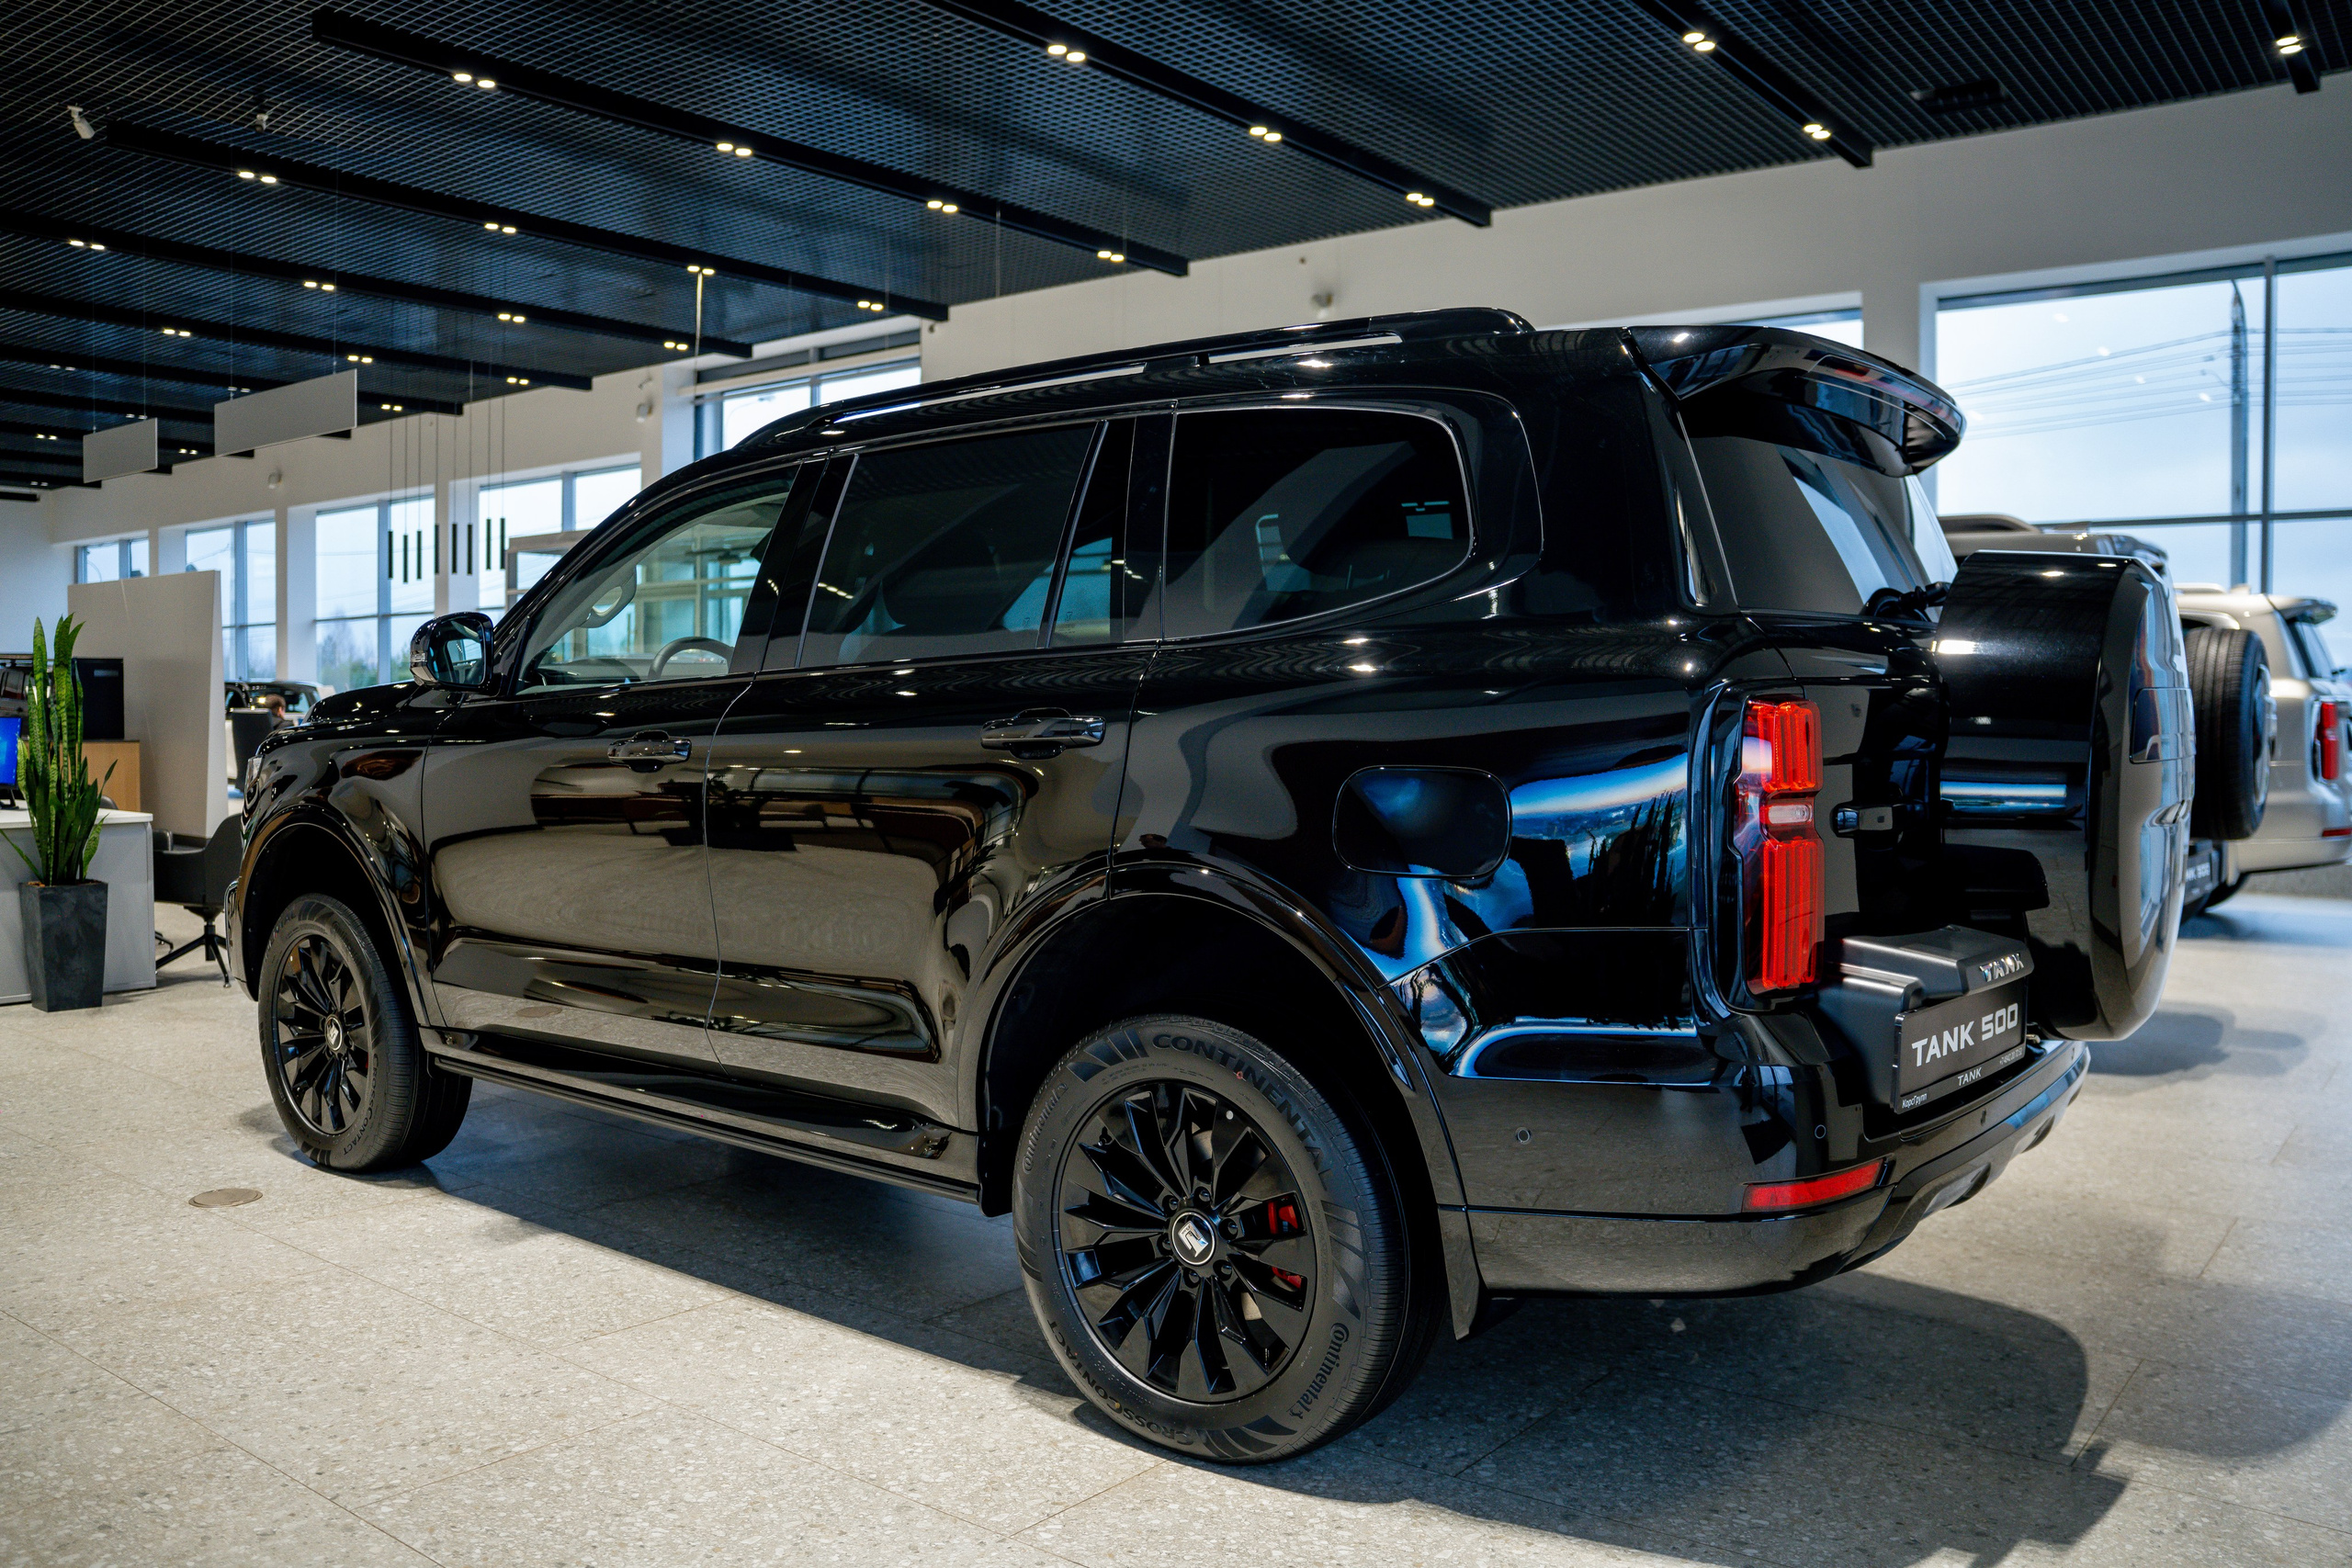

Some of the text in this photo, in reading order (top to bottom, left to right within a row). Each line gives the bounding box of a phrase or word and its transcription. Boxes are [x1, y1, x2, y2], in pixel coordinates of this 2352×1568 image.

[1979, 953, 2025, 982] TANK
[1912, 1020, 1975, 1067] TANK
[1981, 1002, 2019, 1042] 500
[1152, 1033, 1333, 1191] CONTINENTAL
[1957, 1066, 1983, 1087] TANK
[1022, 1089, 1061, 1175] Continental
[1295, 1322, 1351, 1413] Continental
